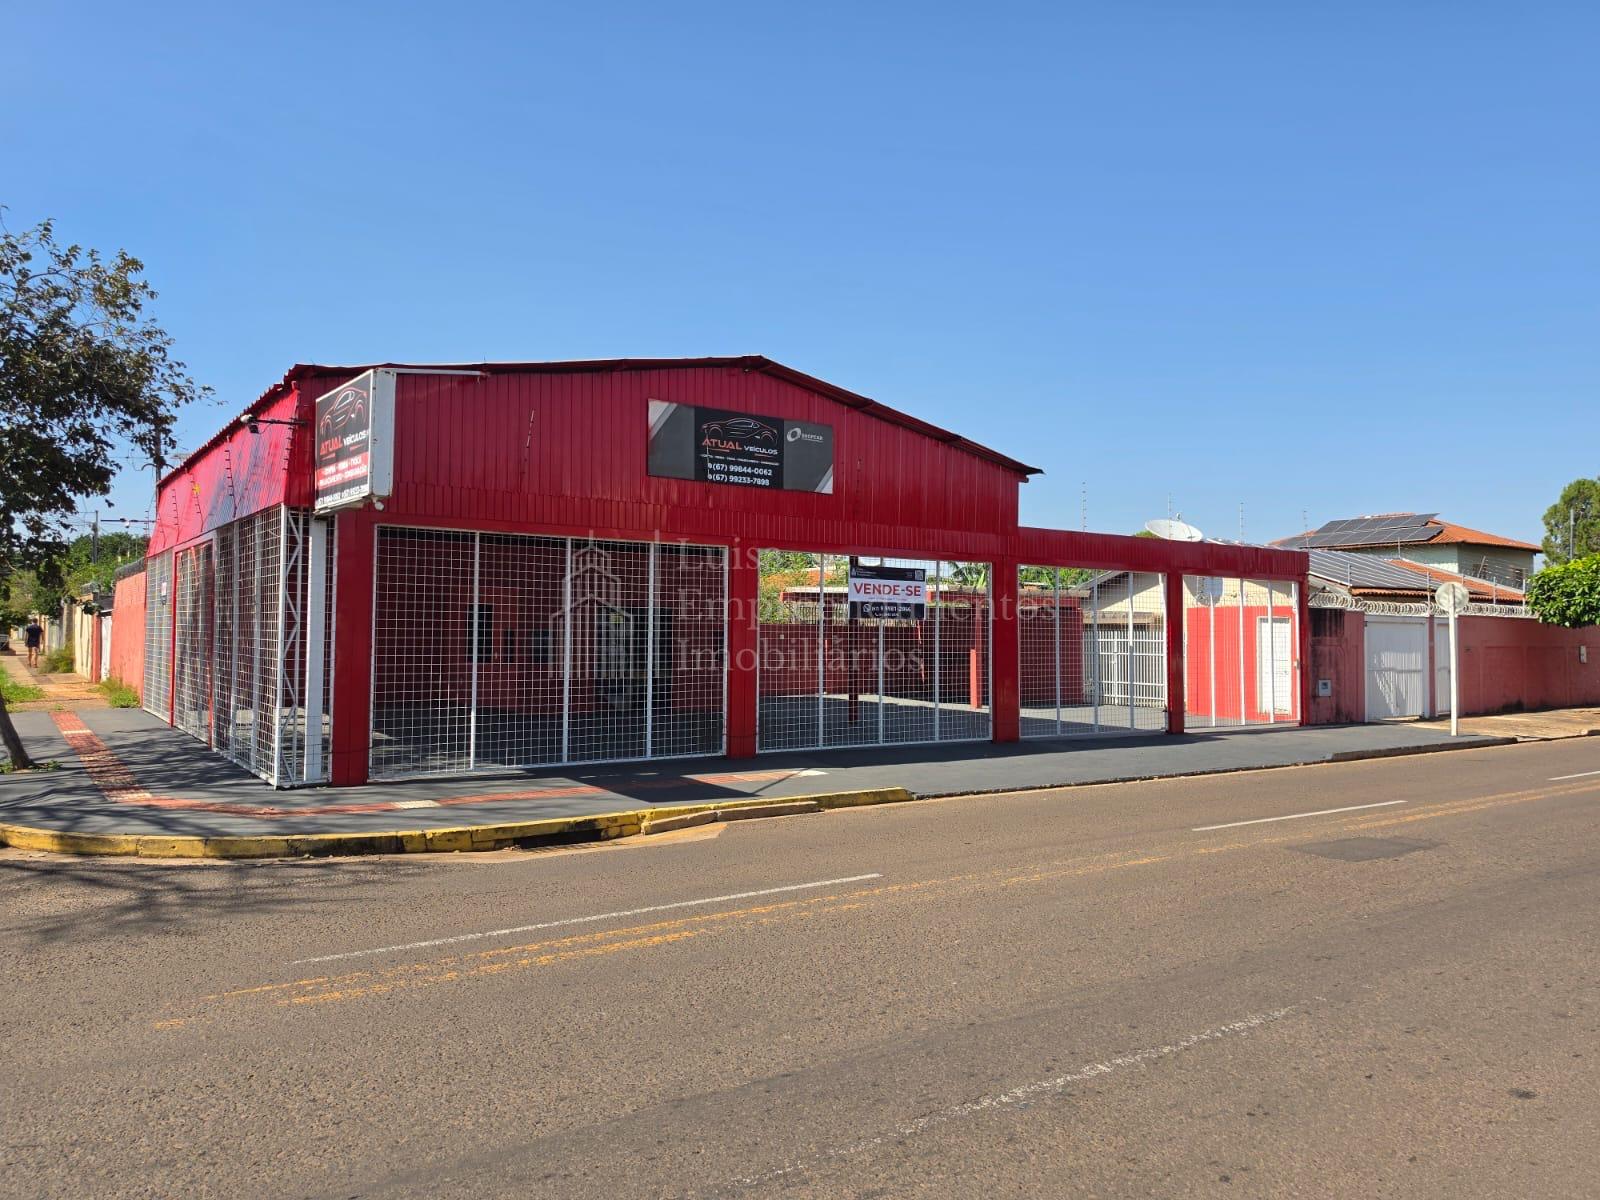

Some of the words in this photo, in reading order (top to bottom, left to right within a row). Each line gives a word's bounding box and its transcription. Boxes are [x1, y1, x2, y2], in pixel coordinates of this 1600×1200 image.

[320, 436, 343, 455] ATUAL
[702, 438, 742, 450] ATUAL
[712, 462, 728, 472] (67)
[712, 473, 728, 484] (67)
[853, 582, 922, 597] VENDE-SE
